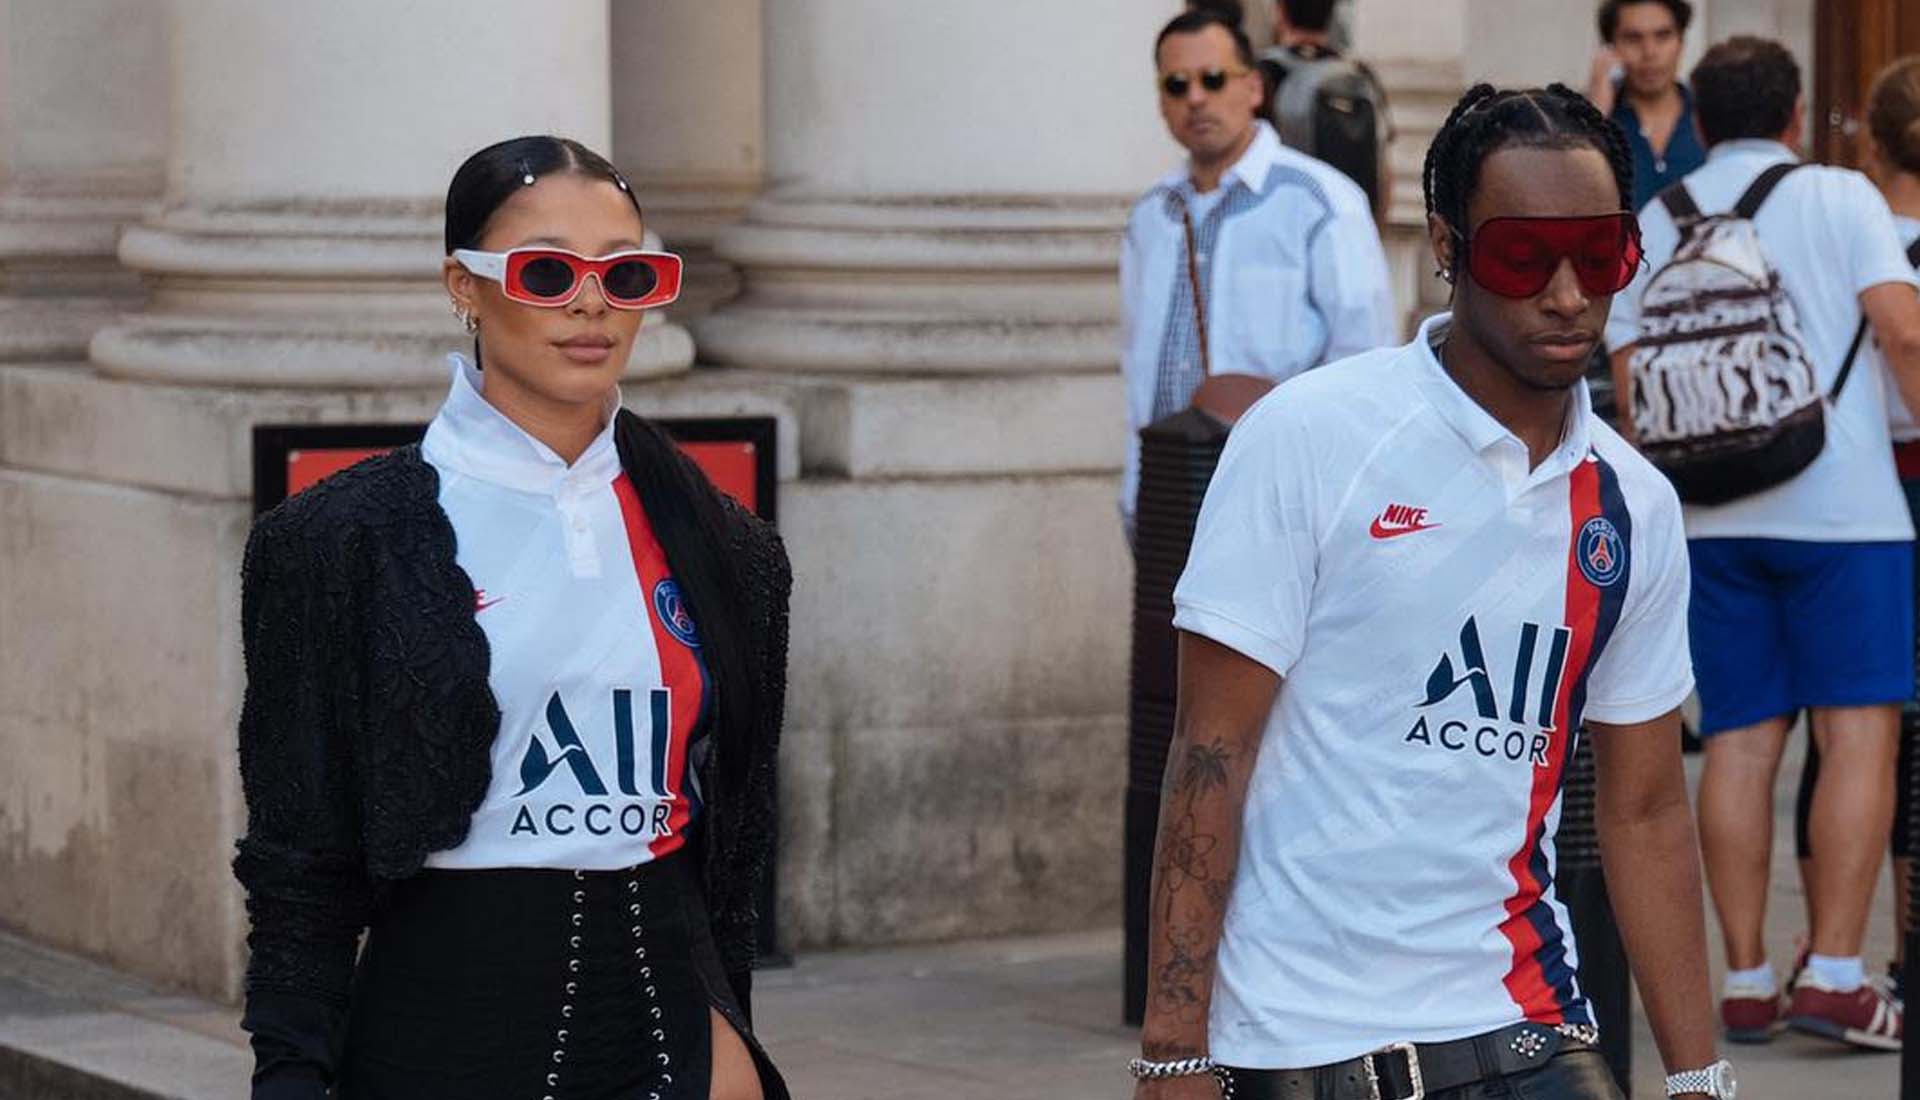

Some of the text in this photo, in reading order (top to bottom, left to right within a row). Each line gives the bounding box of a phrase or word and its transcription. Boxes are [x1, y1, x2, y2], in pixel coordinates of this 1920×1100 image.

[1382, 503, 1428, 526] NIKE
[1586, 520, 1618, 545] PARIS
[1405, 715, 1549, 765] ACCOR
[509, 803, 672, 836] ACCOR
